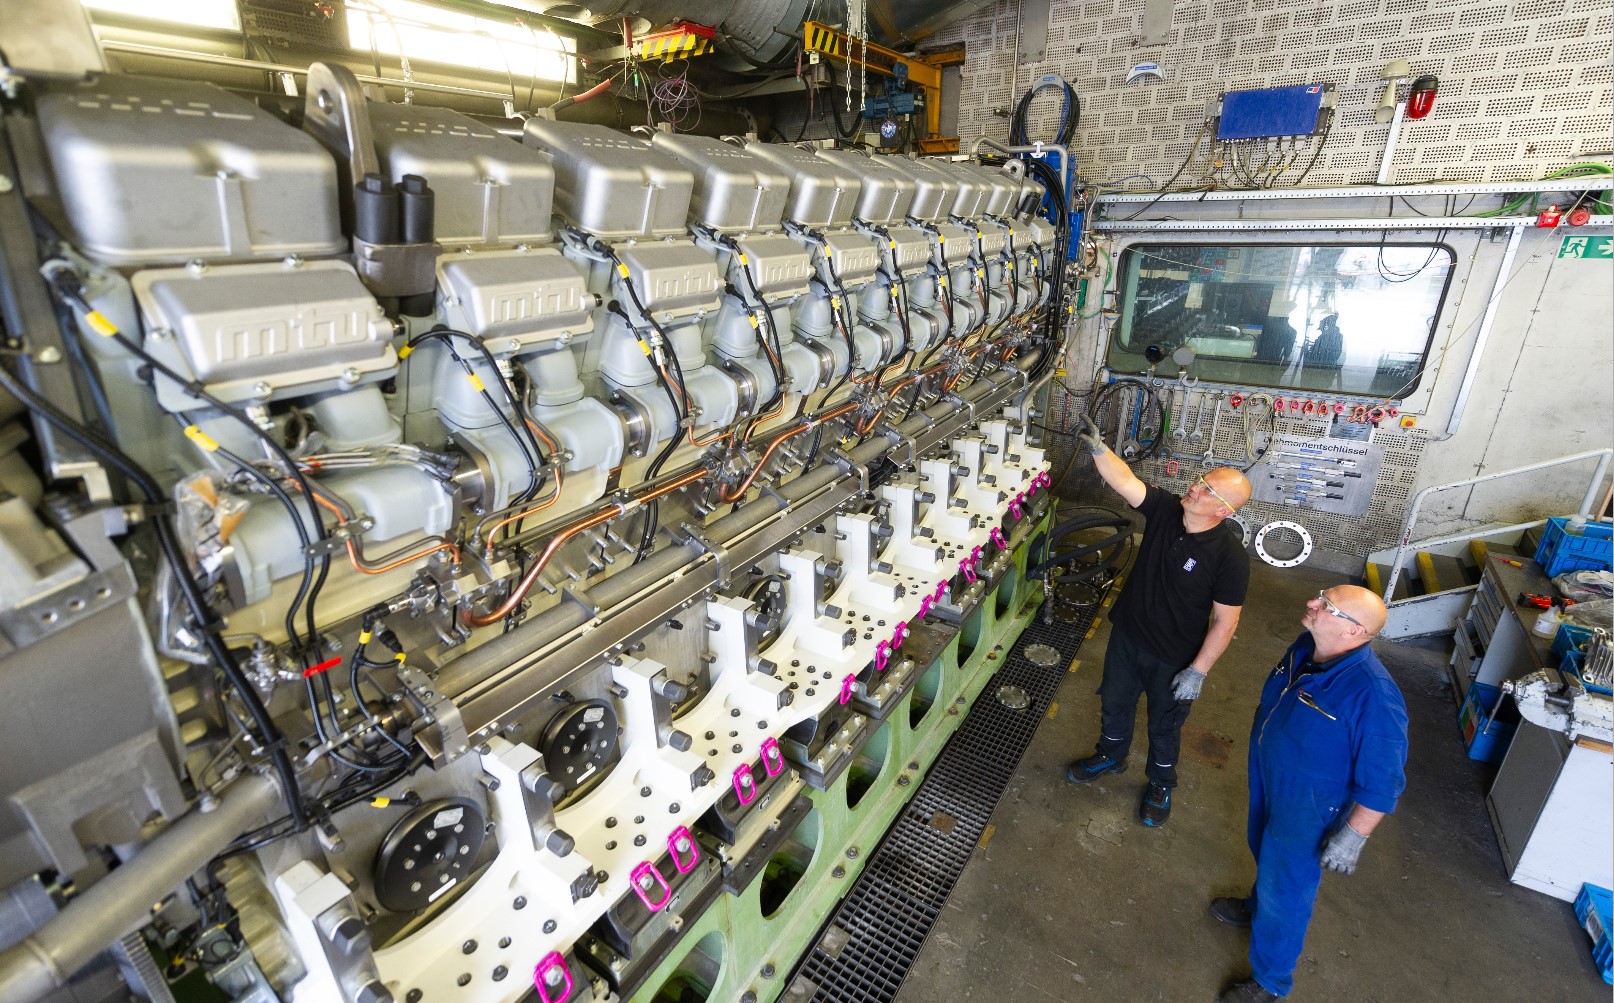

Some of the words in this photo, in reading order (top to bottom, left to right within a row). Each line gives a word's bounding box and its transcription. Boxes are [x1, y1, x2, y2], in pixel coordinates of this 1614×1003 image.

[766, 260, 807, 283] mtu
[843, 251, 876, 272] mtu
[656, 271, 714, 299] mtu
[491, 284, 581, 323] mtu
[217, 308, 369, 361] mtu
[1263, 436, 1368, 456] Dehmomentschlüssel
